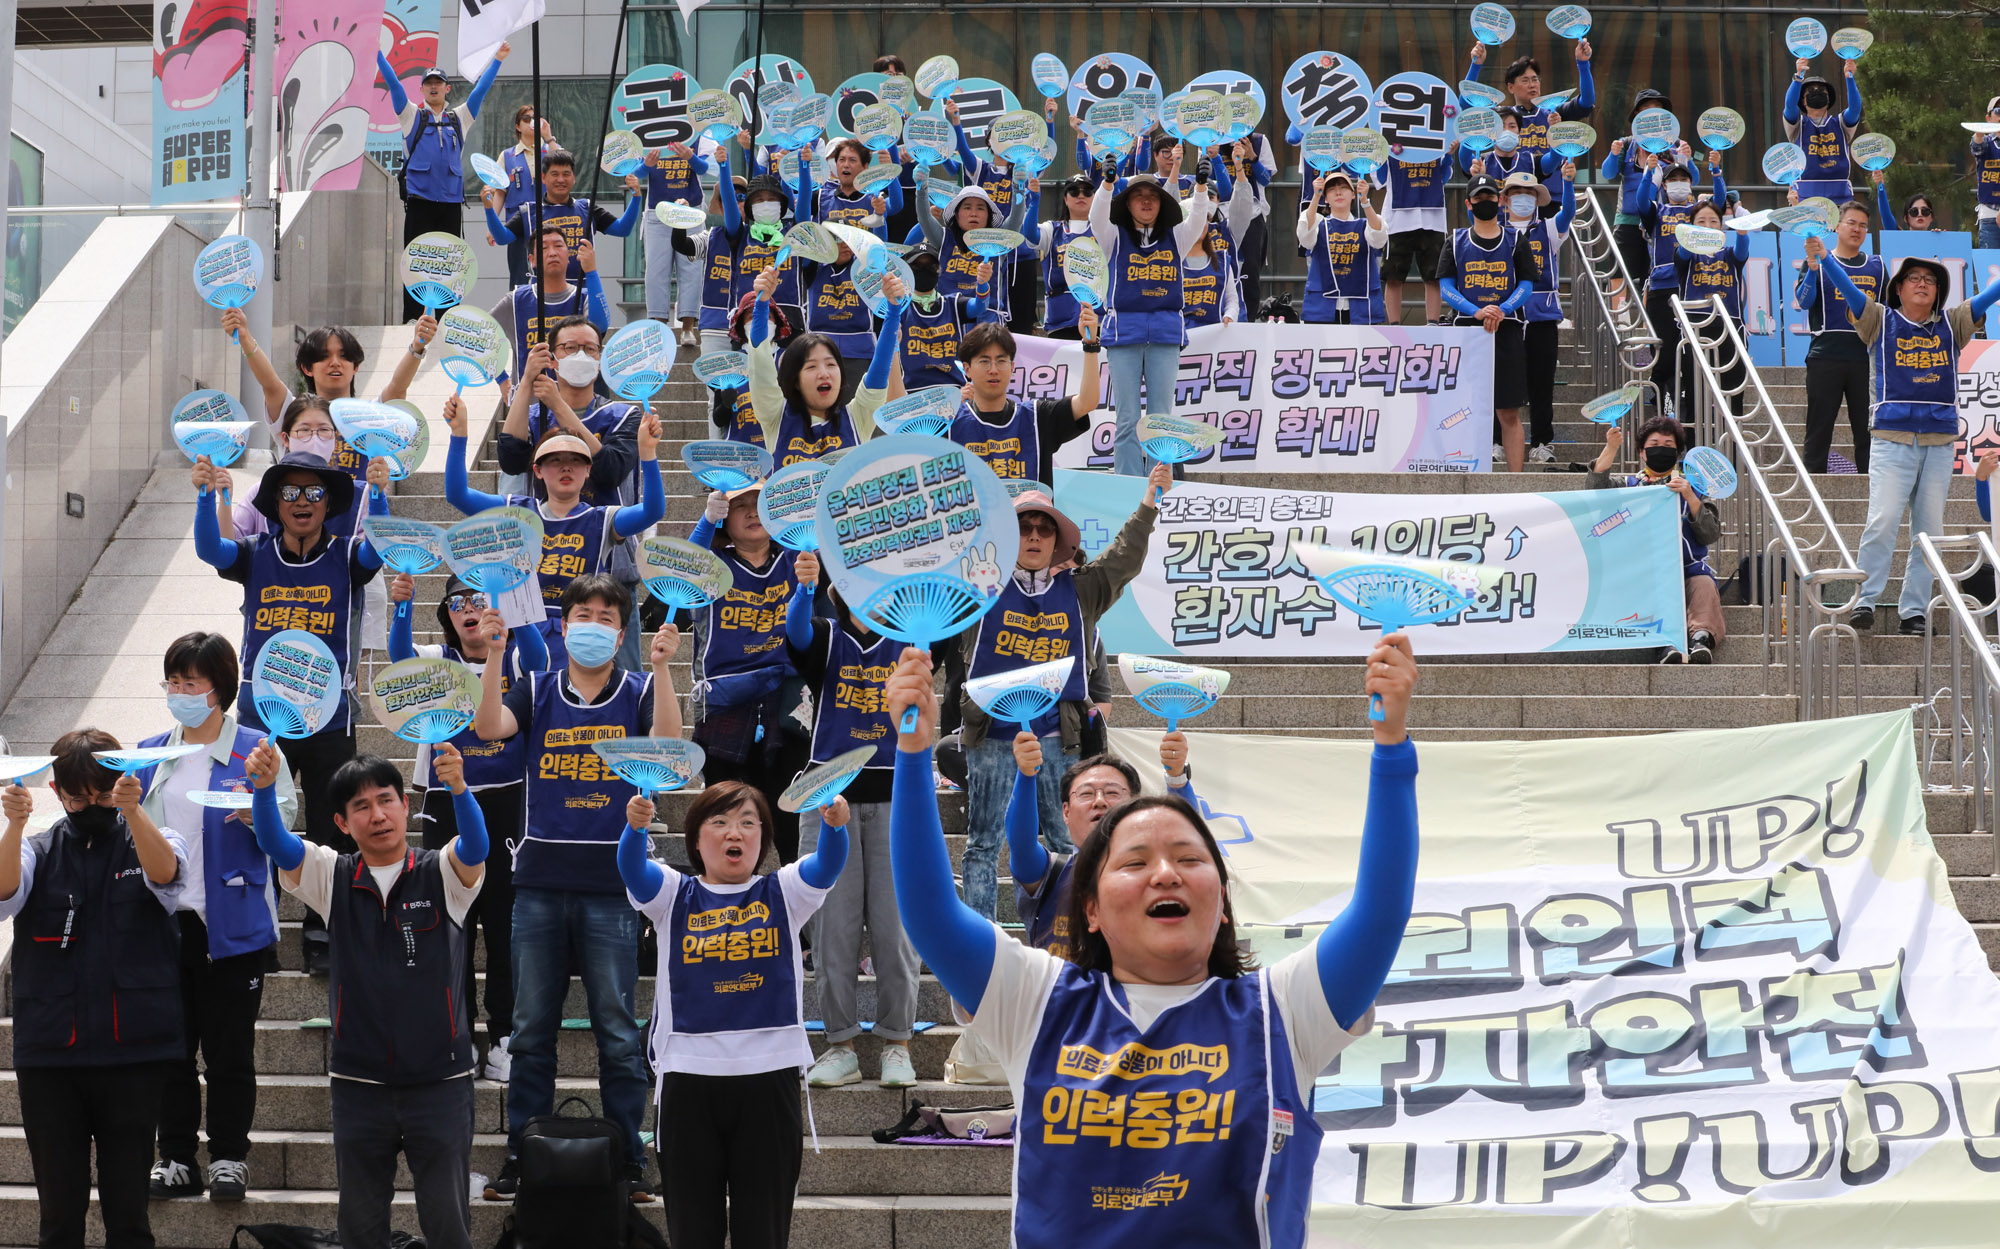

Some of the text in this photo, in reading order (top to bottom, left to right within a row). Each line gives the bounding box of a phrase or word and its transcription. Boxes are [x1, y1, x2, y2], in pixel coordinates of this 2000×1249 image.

[624, 75, 694, 150] 공
[1284, 55, 1371, 132] 충
[1379, 81, 1449, 152] 원
[181, 119, 200, 129] make
[202, 119, 216, 128] you
[217, 116, 231, 125] feel
[163, 129, 231, 162] SUPER
[163, 154, 231, 188] HAPPY
[409, 243, 449, 260] 병원인력
[410, 257, 454, 276] 환자안전
[1127, 264, 1177, 282] 인력충원!
[1464, 273, 1509, 291] 인력충원!
[444, 313, 482, 336] 병원인력
[445, 329, 486, 353] 환자안전
[908, 340, 958, 359] 인력충원!
[1895, 350, 1949, 369] 인력충원!
[1273, 344, 1461, 401] 정규직화!
[1002, 440, 1019, 449] 아니다
[1277, 405, 1380, 463] 확대!
[765, 475, 810, 499] 윤석열정권
[826, 451, 966, 514] 윤석열정권 퇴진!
[767, 487, 814, 511] 의료민영화
[1160, 494, 1333, 524] 간호인력 충원!
[835, 480, 976, 544] 의료민영화 저지!
[560, 534, 582, 546] 아니다
[842, 528, 945, 569] 간호인력인권법
[946, 507, 982, 536] 제정!
[264, 589, 288, 600] 의료는
[306, 587, 328, 599] 아니다
[255, 606, 335, 634] 인력충원!
[1007, 613, 1065, 628] 의료는 아니다
[1172, 585, 1338, 647] 환자수
[269, 640, 335, 674] 윤석열정권 퇴진!
[994, 630, 1071, 661] 인력충원!
[264, 655, 331, 688] 의료민영화 저지!
[306, 685, 325, 700] 제정!
[374, 674, 431, 697] 병원인력
[385, 683, 446, 714] 환자안전
[547, 728, 623, 744] 의료는 상품이 아니다
[565, 799, 603, 809] 의료연대본부
[1607, 759, 1868, 878] UP!
[691, 914, 717, 928] 의료는
[741, 904, 767, 922] 아니다
[682, 926, 779, 964] 인력충원!
[714, 981, 757, 994] 의료연대본부
[1119, 1048, 1163, 1075] 상품이
[1170, 1049, 1222, 1070] 아니다
[1042, 1086, 1236, 1149] 인력충원!
[1349, 1110, 1699, 1211] UP!
[1092, 1189, 1175, 1211] 의료연대본부
